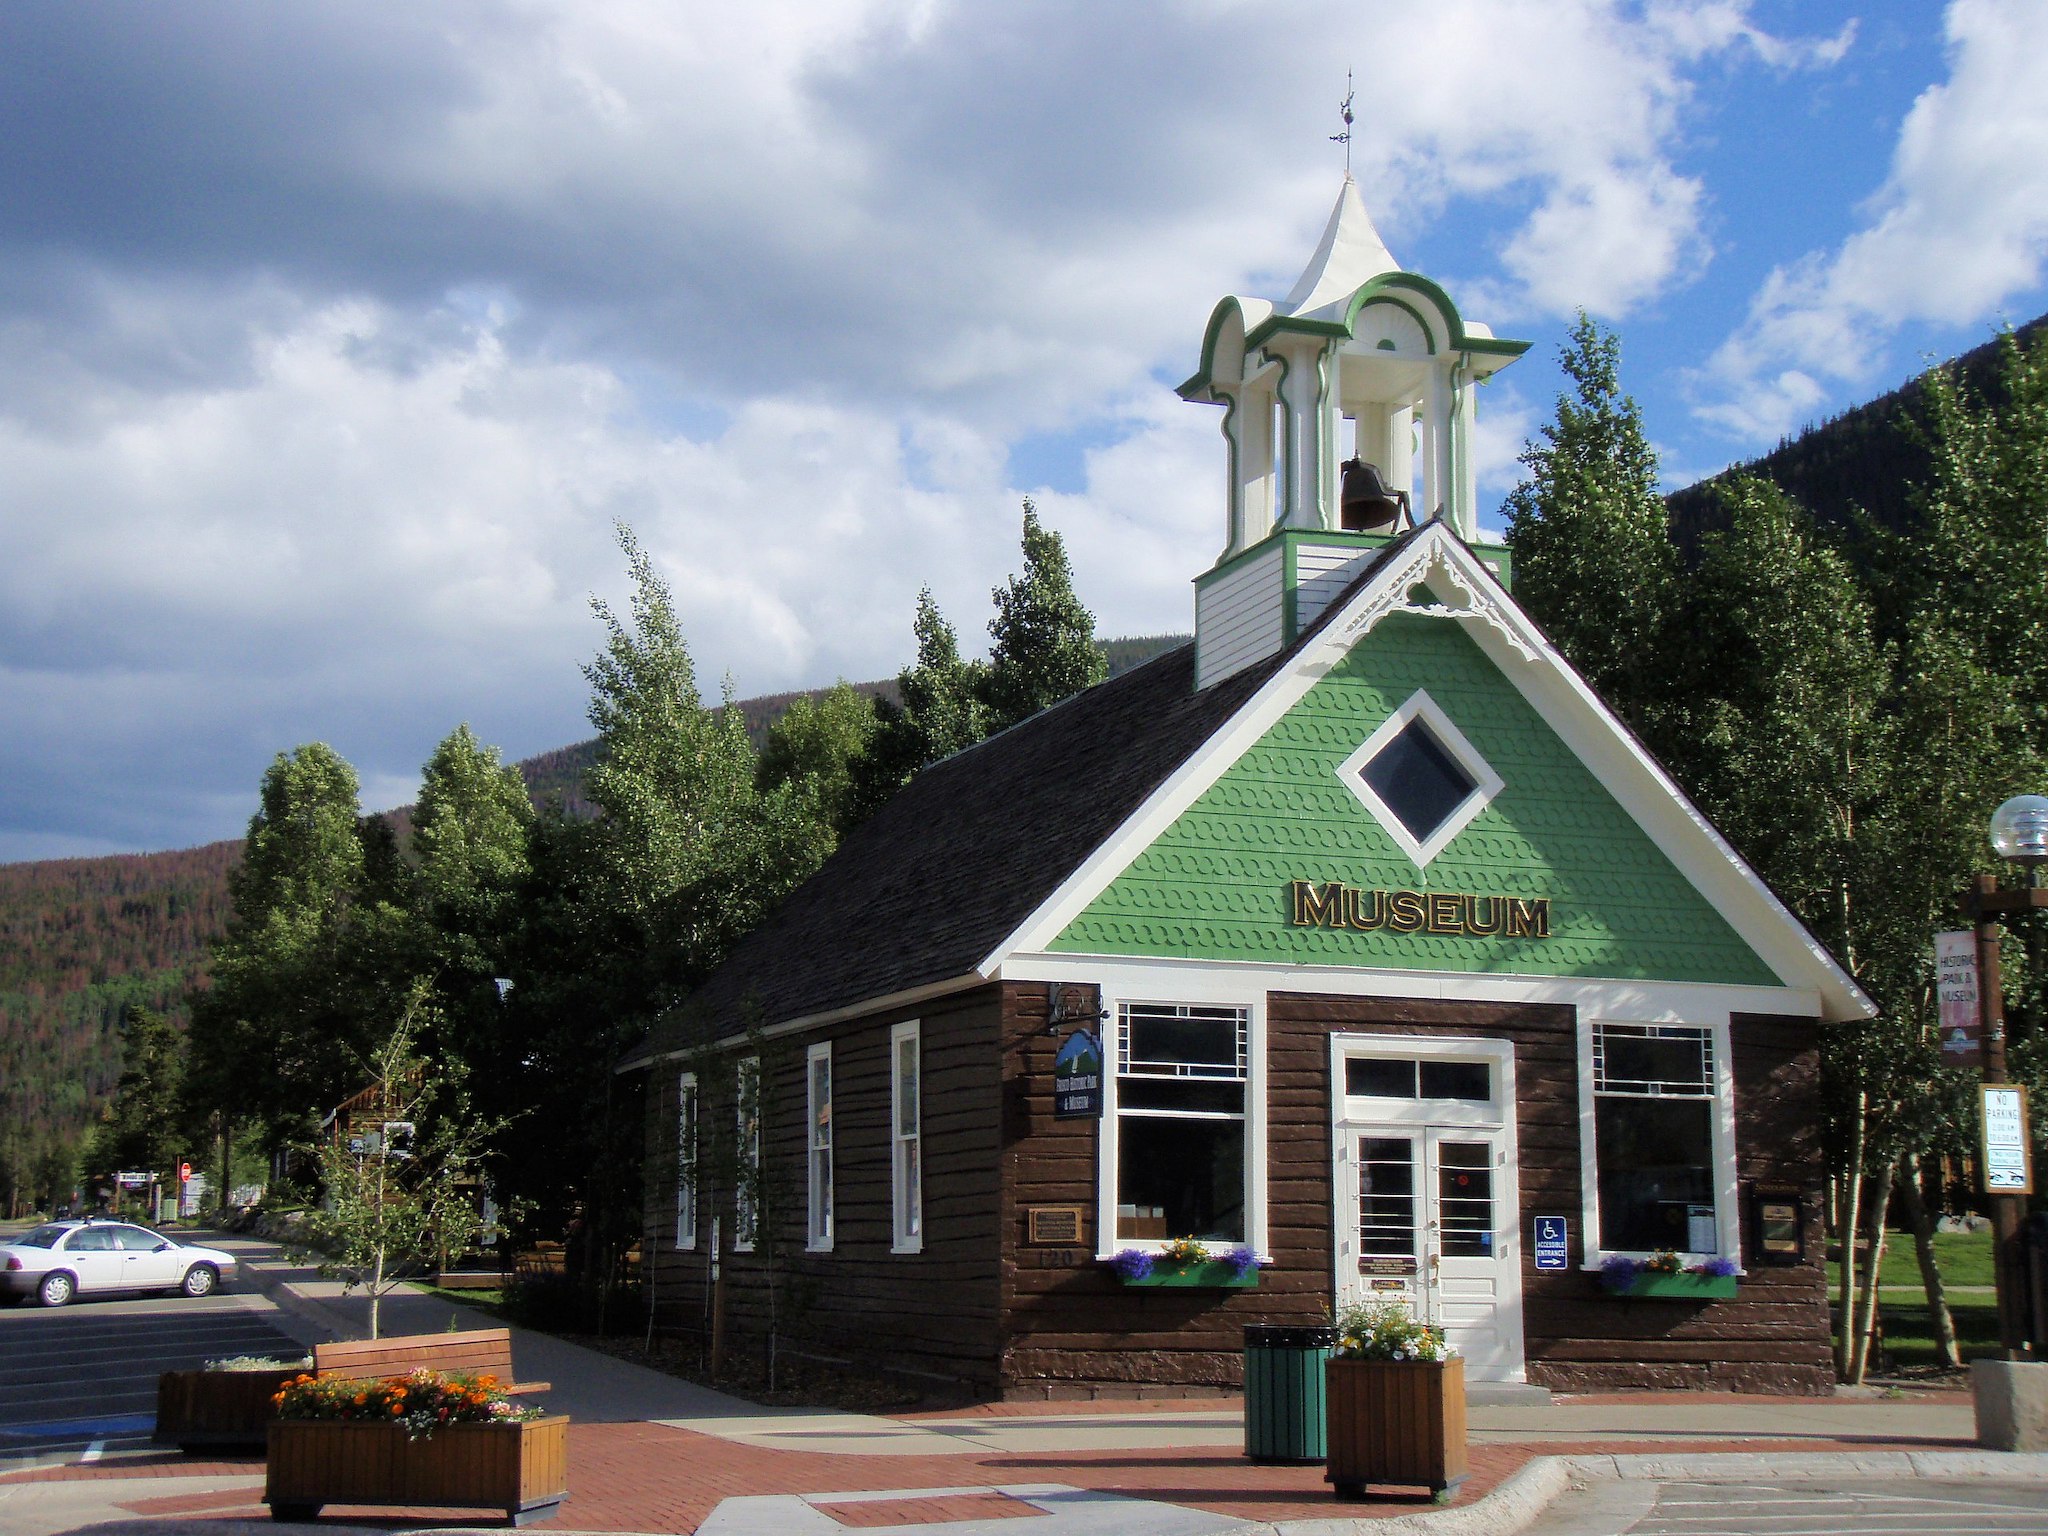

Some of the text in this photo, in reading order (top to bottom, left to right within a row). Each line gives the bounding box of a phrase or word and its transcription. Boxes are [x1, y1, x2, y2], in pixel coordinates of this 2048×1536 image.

[1291, 880, 1551, 938] MUSEUM
[1941, 955, 1976, 967] HISTORIC
[1941, 990, 1976, 1003] MUSEUM
[1996, 1094, 2007, 1106] NO
[1987, 1109, 2018, 1120] PARKING
[1538, 1241, 1565, 1249] ACCESSIBLE
